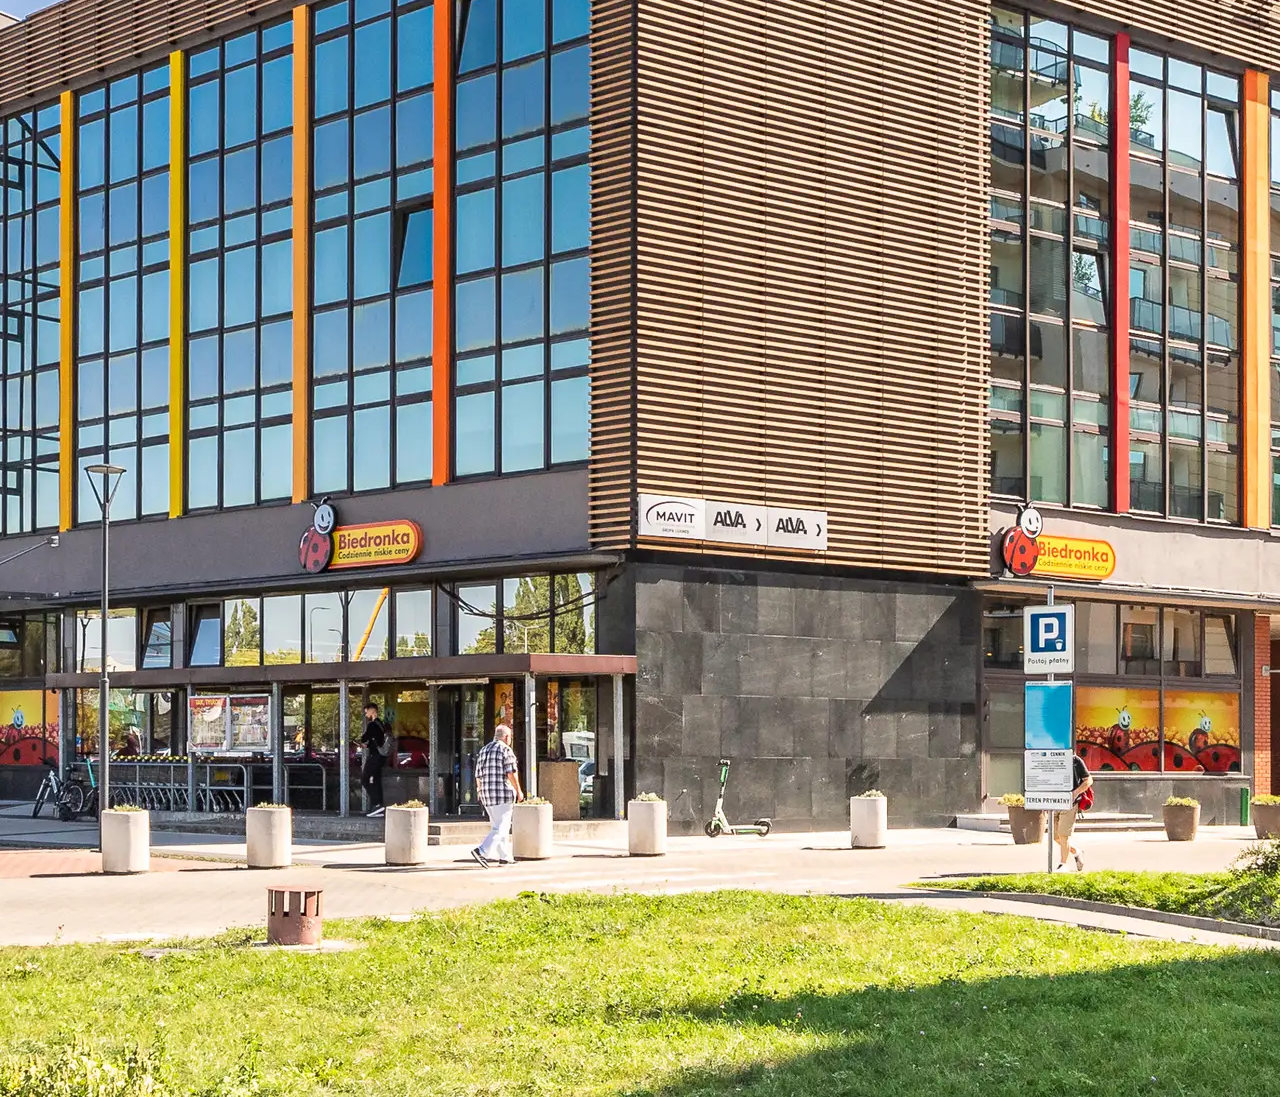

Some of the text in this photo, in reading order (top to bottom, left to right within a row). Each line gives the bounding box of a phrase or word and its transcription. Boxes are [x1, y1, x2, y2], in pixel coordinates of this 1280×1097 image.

[656, 510, 695, 524] MAVIT
[338, 529, 410, 550] Biedronka
[338, 547, 410, 559] Codziennie niskie ceny
[1038, 541, 1109, 563] Biedronka
[1038, 558, 1109, 573] Codziennie niskie ceny
[1039, 617, 1059, 648] P
[1049, 657, 1070, 665] płatny
